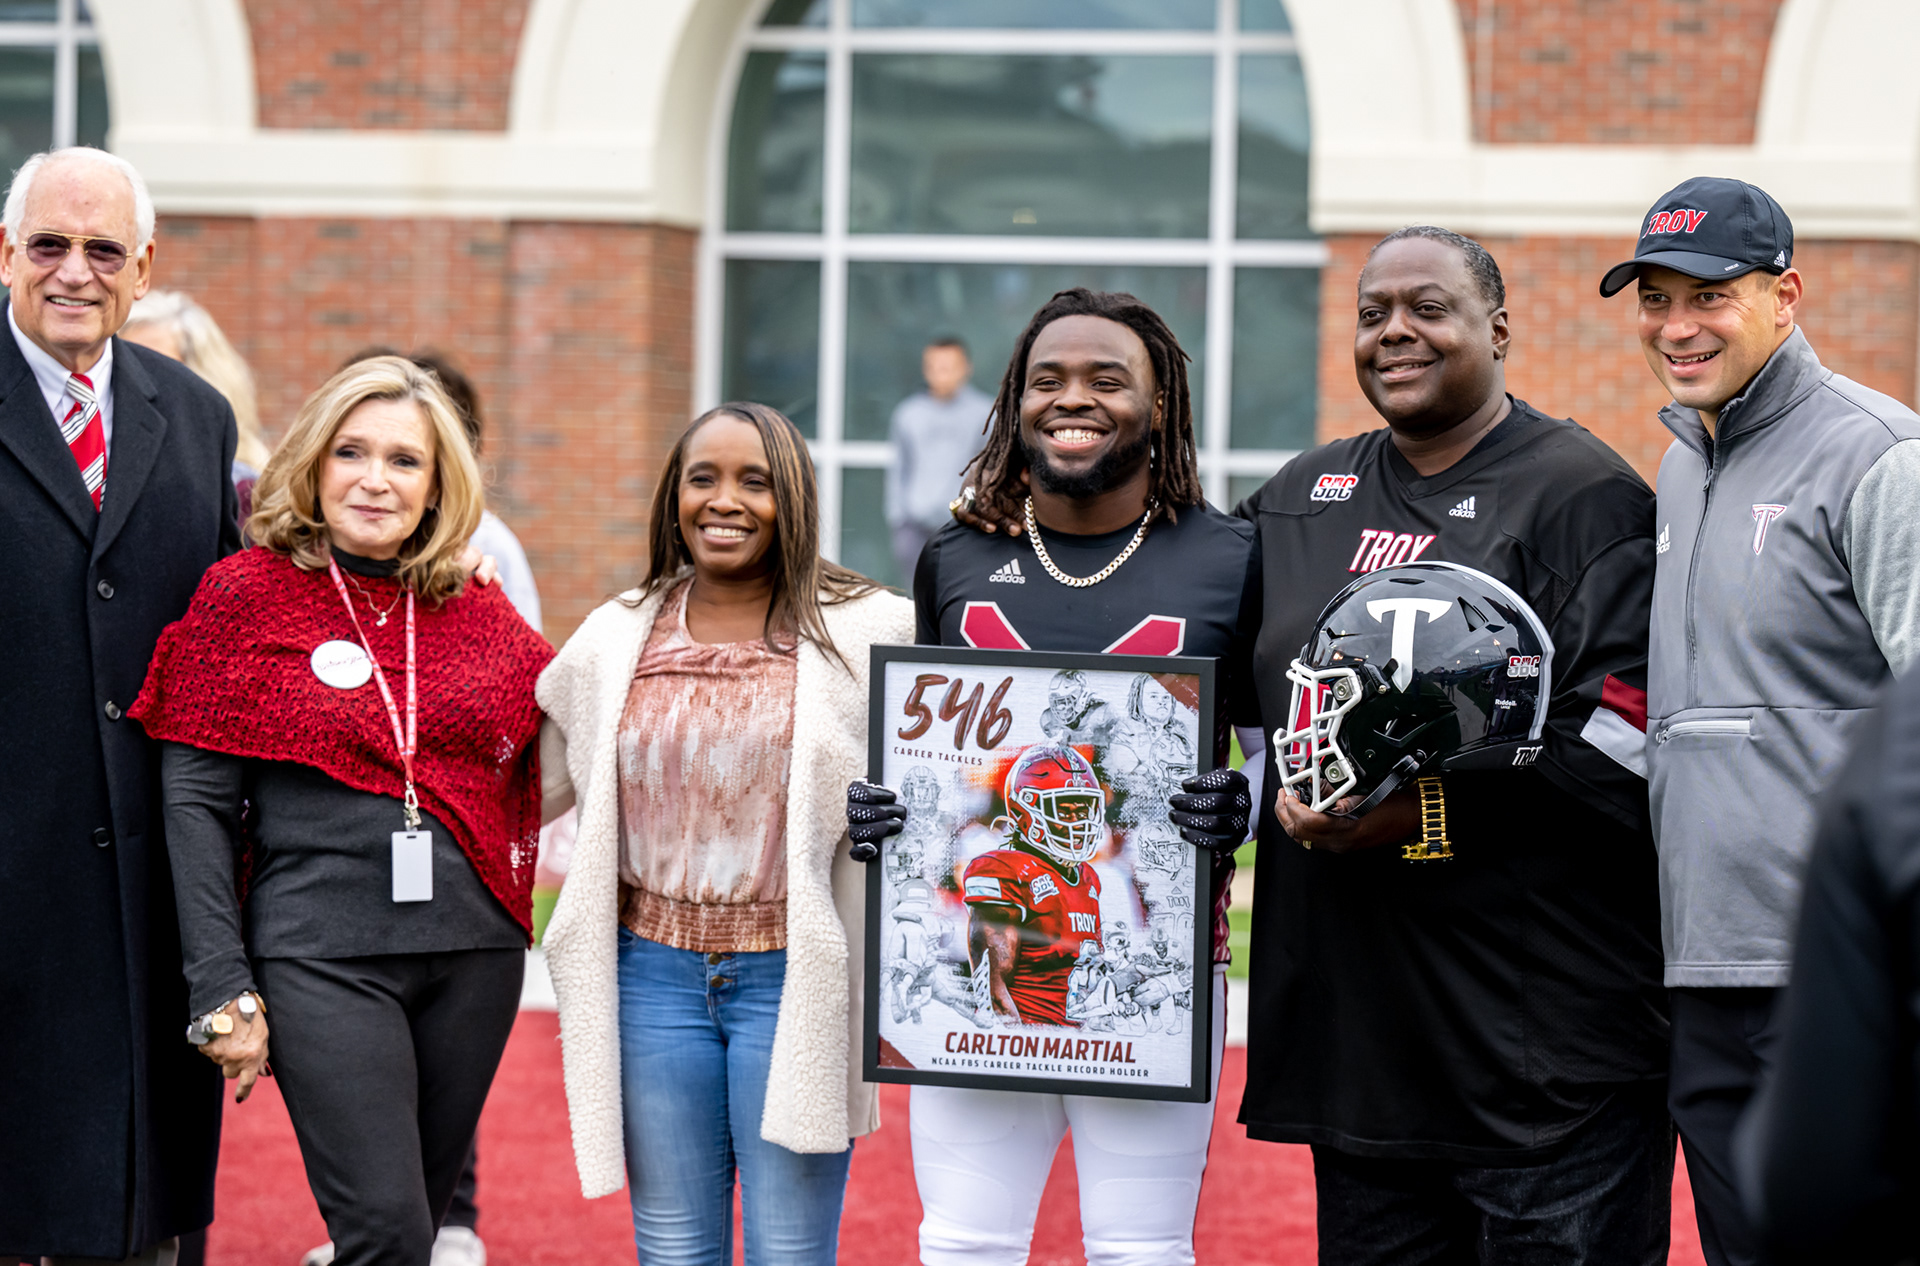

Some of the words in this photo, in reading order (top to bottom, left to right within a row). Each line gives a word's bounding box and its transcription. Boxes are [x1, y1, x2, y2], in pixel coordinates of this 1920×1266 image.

[1642, 208, 1709, 239] TROY
[1310, 473, 1359, 501] SBC
[1449, 508, 1476, 519] adidas
[1347, 529, 1437, 573] TROY
[989, 573, 1026, 585] adidas
[1507, 655, 1540, 677] SBC
[898, 673, 1014, 751] 546
[893, 746, 933, 759] CAREER
[938, 752, 983, 766] TACKLES
[1067, 911, 1097, 934] TROY
[945, 1031, 1040, 1058] CARLTON
[1041, 1036, 1137, 1063] MARTIAL
[931, 1057, 957, 1066] NCAA
[961, 1058, 980, 1068] FBS
[983, 1060, 1021, 1070] CAREER
[1026, 1062, 1062, 1072] TACKLE
[1066, 1064, 1105, 1075] RECORD
[1109, 1067, 1149, 1077] HOLDER
